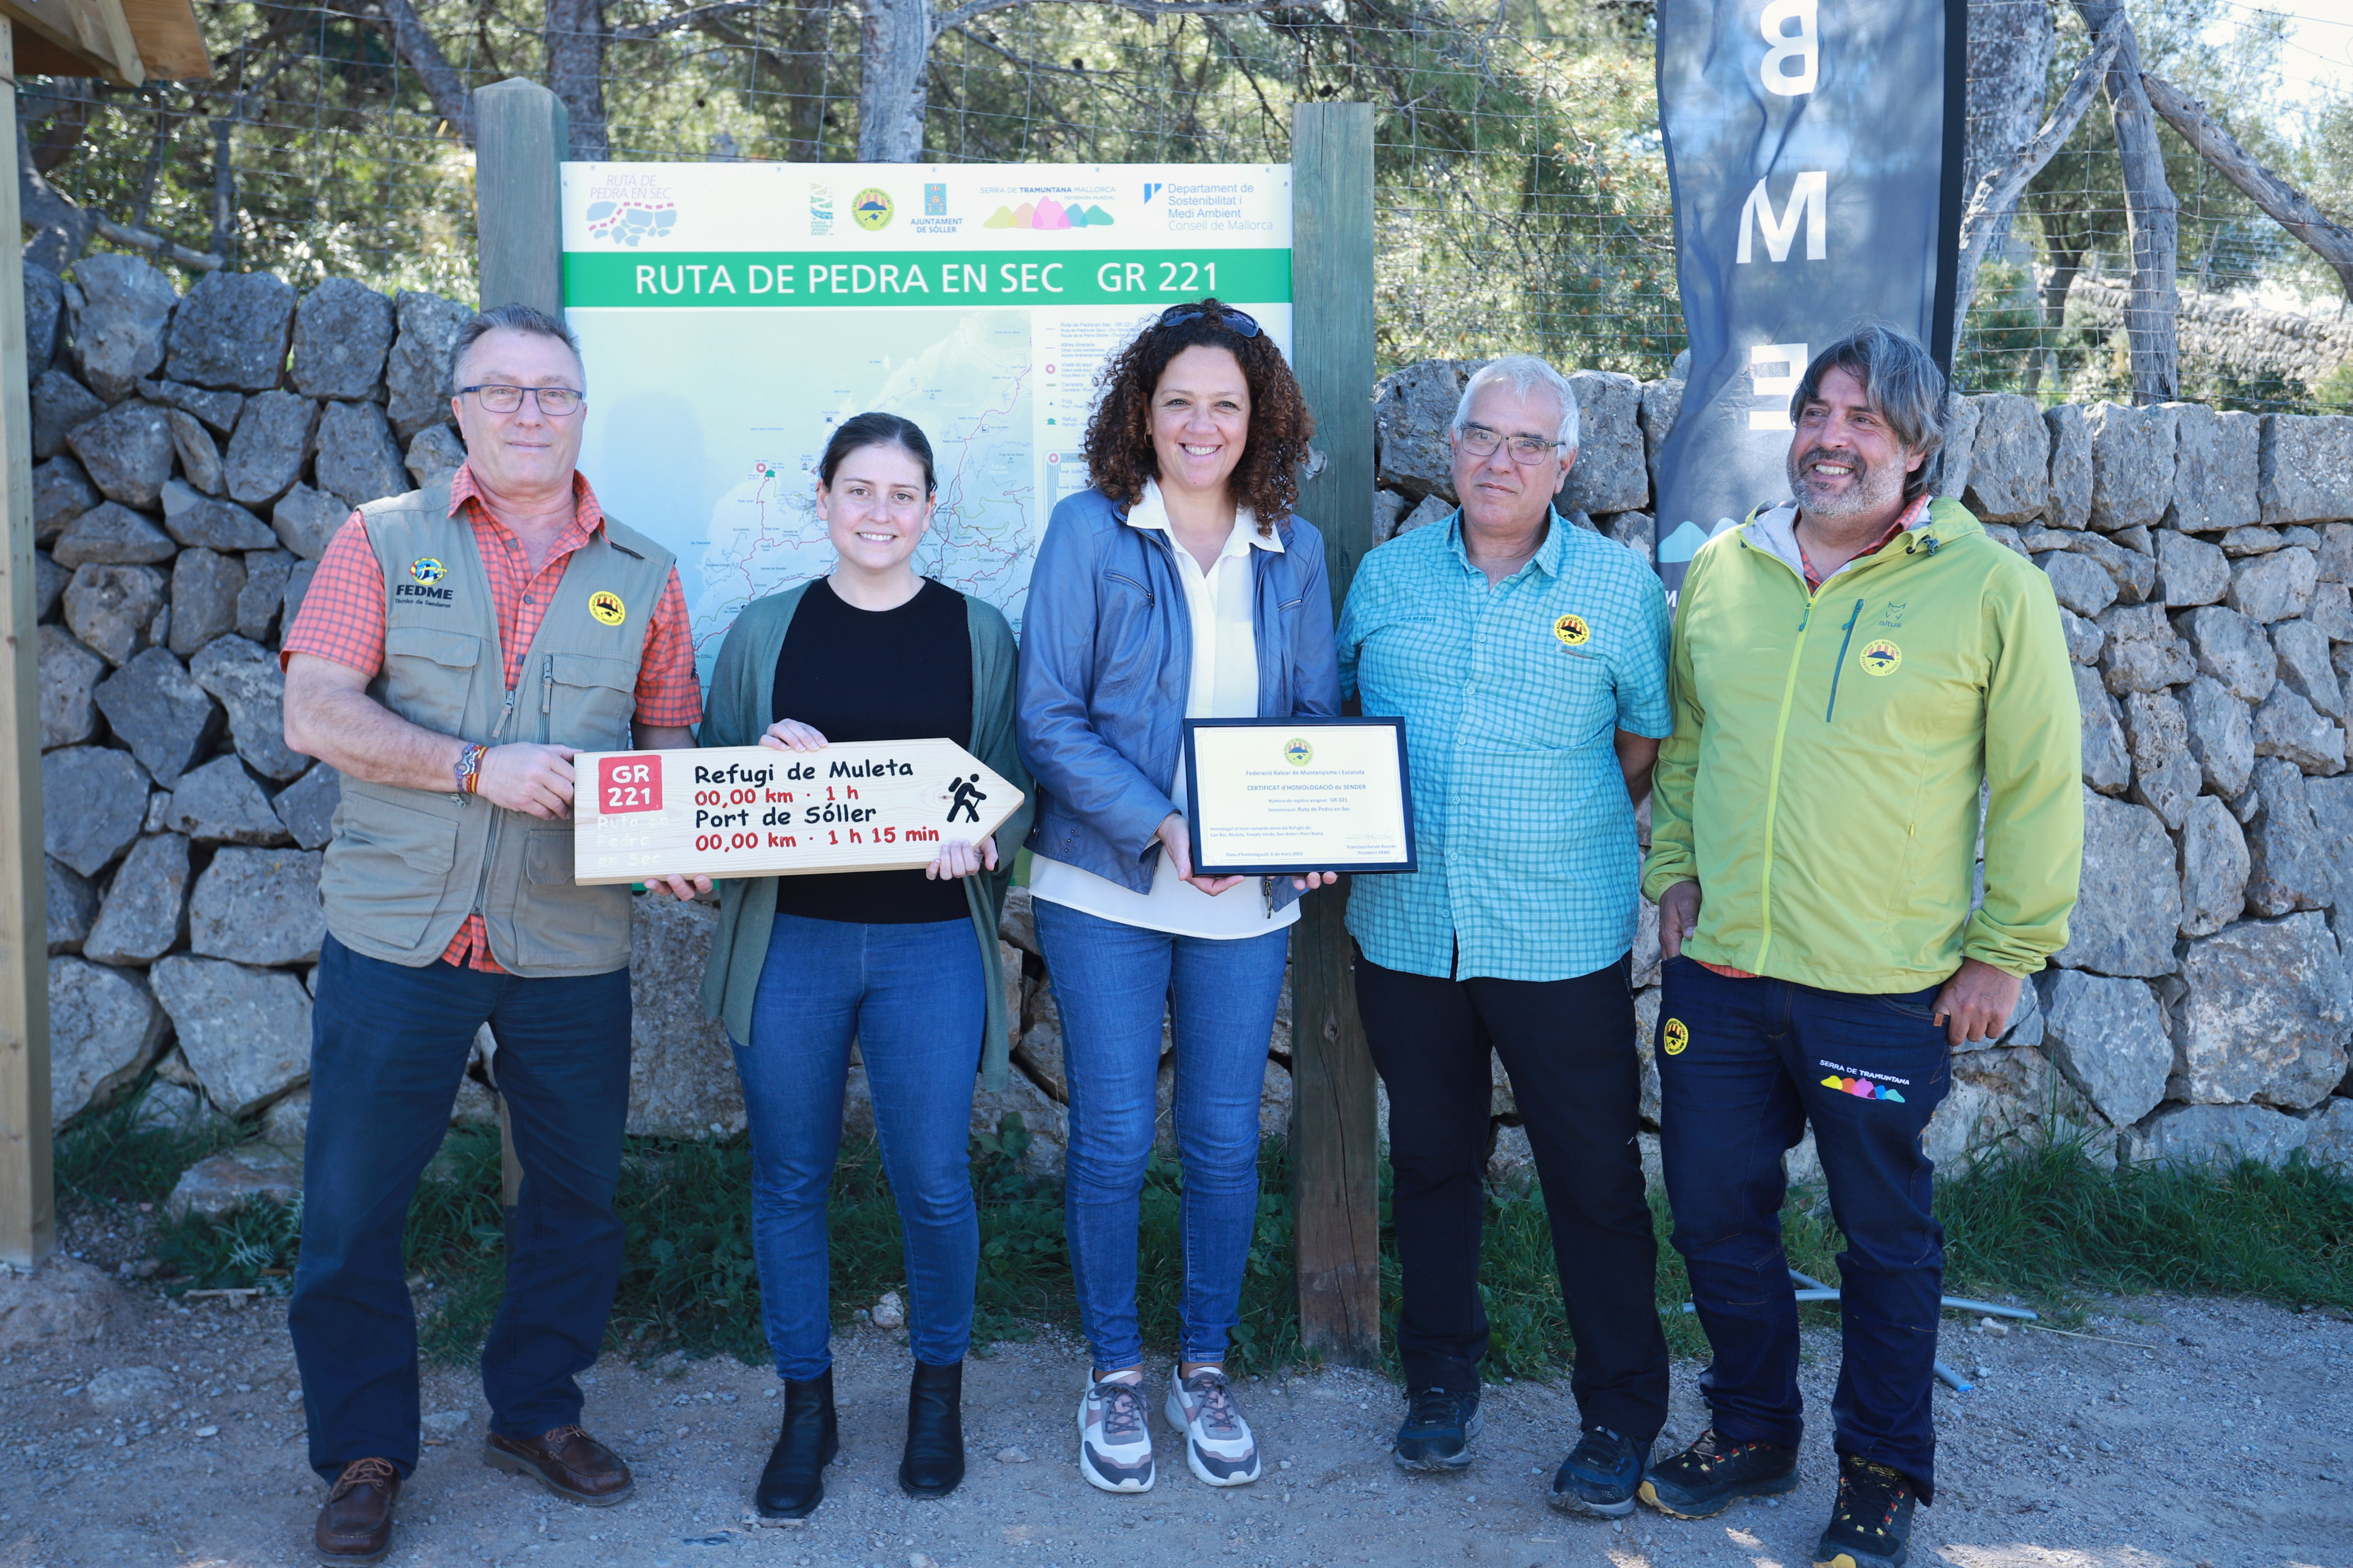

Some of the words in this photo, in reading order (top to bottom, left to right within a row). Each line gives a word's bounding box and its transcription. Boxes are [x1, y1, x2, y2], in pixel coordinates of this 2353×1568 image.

[607, 175, 638, 186] RUTA
[641, 175, 656, 186] DE
[590, 188, 628, 199] PEDRA
[631, 188, 647, 199] EN
[650, 187, 671, 198] SEC
[1168, 183, 1237, 195] Departament
[1240, 183, 1254, 193] de
[1168, 196, 1237, 206] Sostenibilitat
[1239, 196, 1242, 205] i
[1168, 209, 1195, 218] Medi
[1197, 208, 1241, 218] Ambient
[1168, 220, 1208, 231] Consell
[1211, 220, 1225, 230] de
[1227, 220, 1273, 230] Mallorca
[636, 265, 736, 294] RUTA
[749, 265, 794, 294] DE
[809, 265, 929, 293] PEDRA
[942, 264, 987, 292] EN
[1000, 263, 1063, 292] SEC
[1097, 263, 1146, 291] GR
[1159, 262, 1215, 291] 221
[396, 585, 453, 599] FEDME
[612, 765, 650, 783] GR
[696, 763, 774, 788] Refugi
[787, 762, 816, 780] de
[830, 758, 914, 778] Muleta
[608, 787, 651, 807] 221
[694, 789, 757, 808] 00,00
[765, 788, 794, 804] km
[826, 786, 836, 801] 1
[847, 785, 859, 800] h
[597, 816, 640, 830] Ruta
[649, 814, 669, 829] de
[696, 809, 749, 829] Port
[763, 807, 791, 825] de
[806, 801, 877, 822] Sóller
[597, 833, 651, 847] Pedra
[695, 833, 759, 853] 00,00
[769, 831, 797, 848] km
[828, 830, 839, 845] 1
[850, 829, 862, 844] h
[873, 826, 896, 844] 15
[906, 827, 940, 842] min
[598, 855, 619, 867] en
[628, 853, 662, 866] Sec
[1819, 1059, 1845, 1072] SERRA
[1846, 1066, 1857, 1075] DE
[1859, 1069, 1910, 1085] TRAMUNTANA
